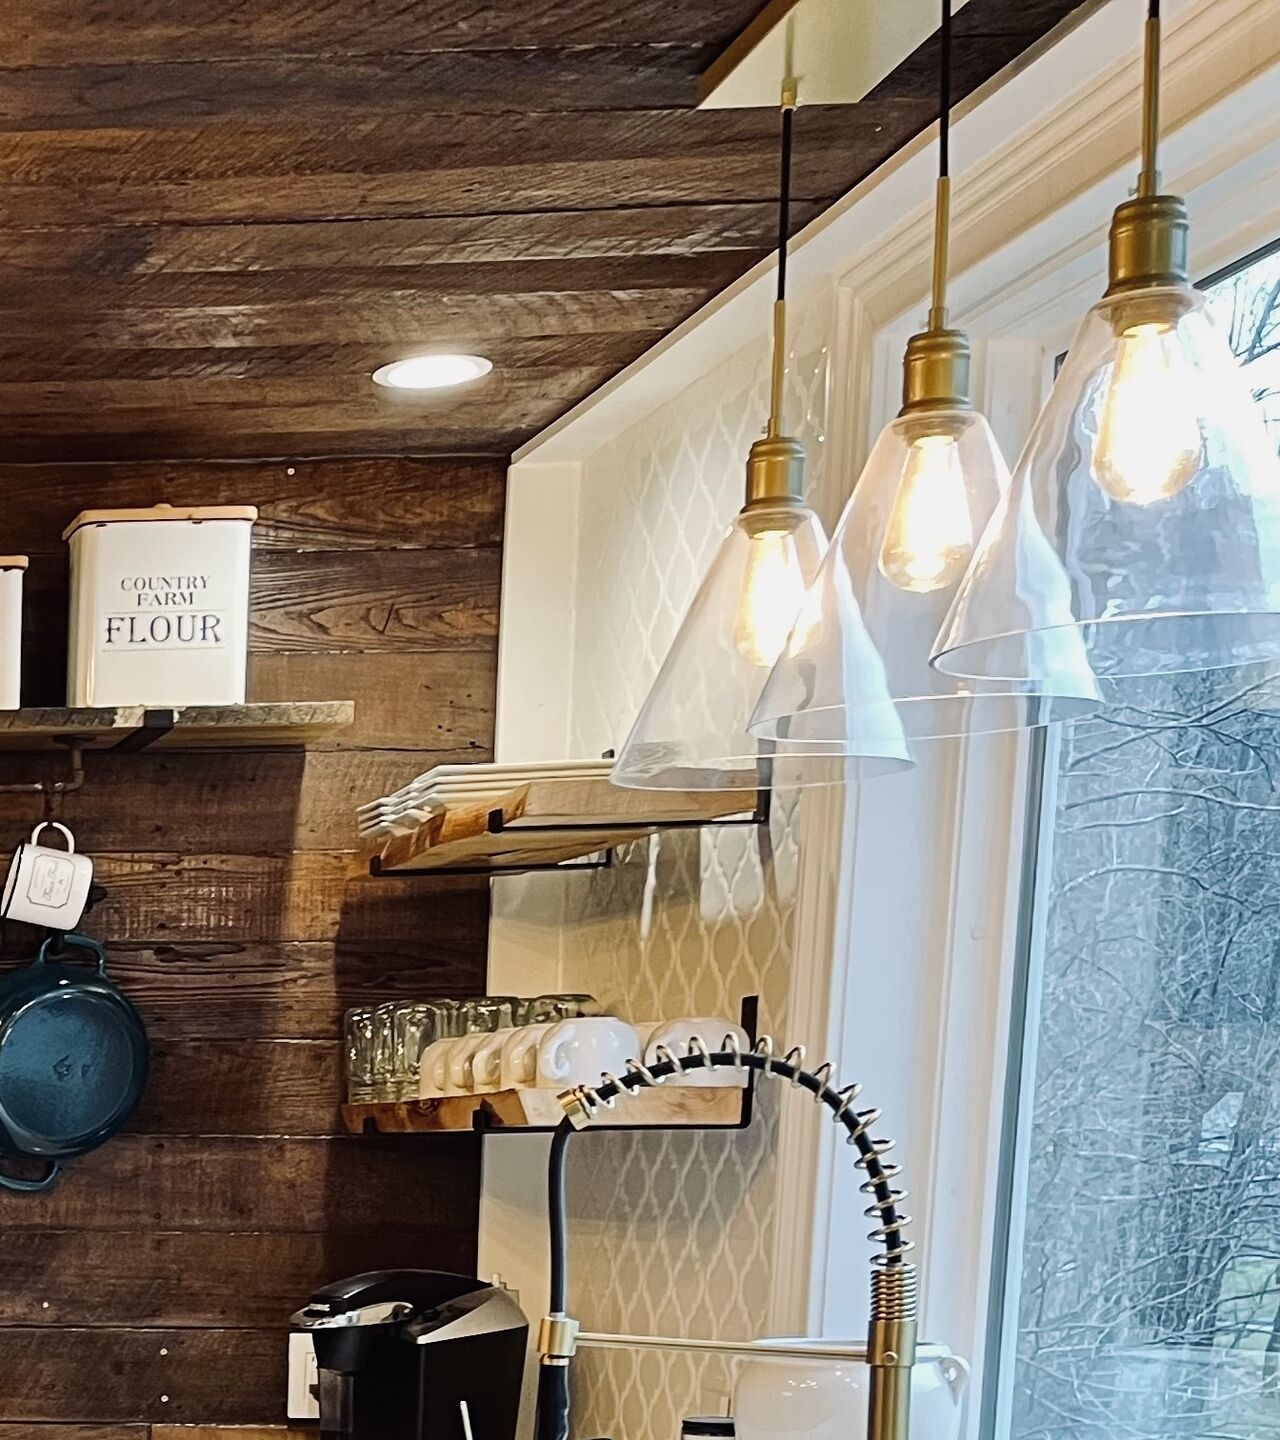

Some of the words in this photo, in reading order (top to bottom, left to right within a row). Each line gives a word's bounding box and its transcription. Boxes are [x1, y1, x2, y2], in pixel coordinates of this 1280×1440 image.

[120, 575, 211, 592] COUNTRY
[136, 592, 195, 607] FARM
[104, 614, 223, 645] FLOUR
